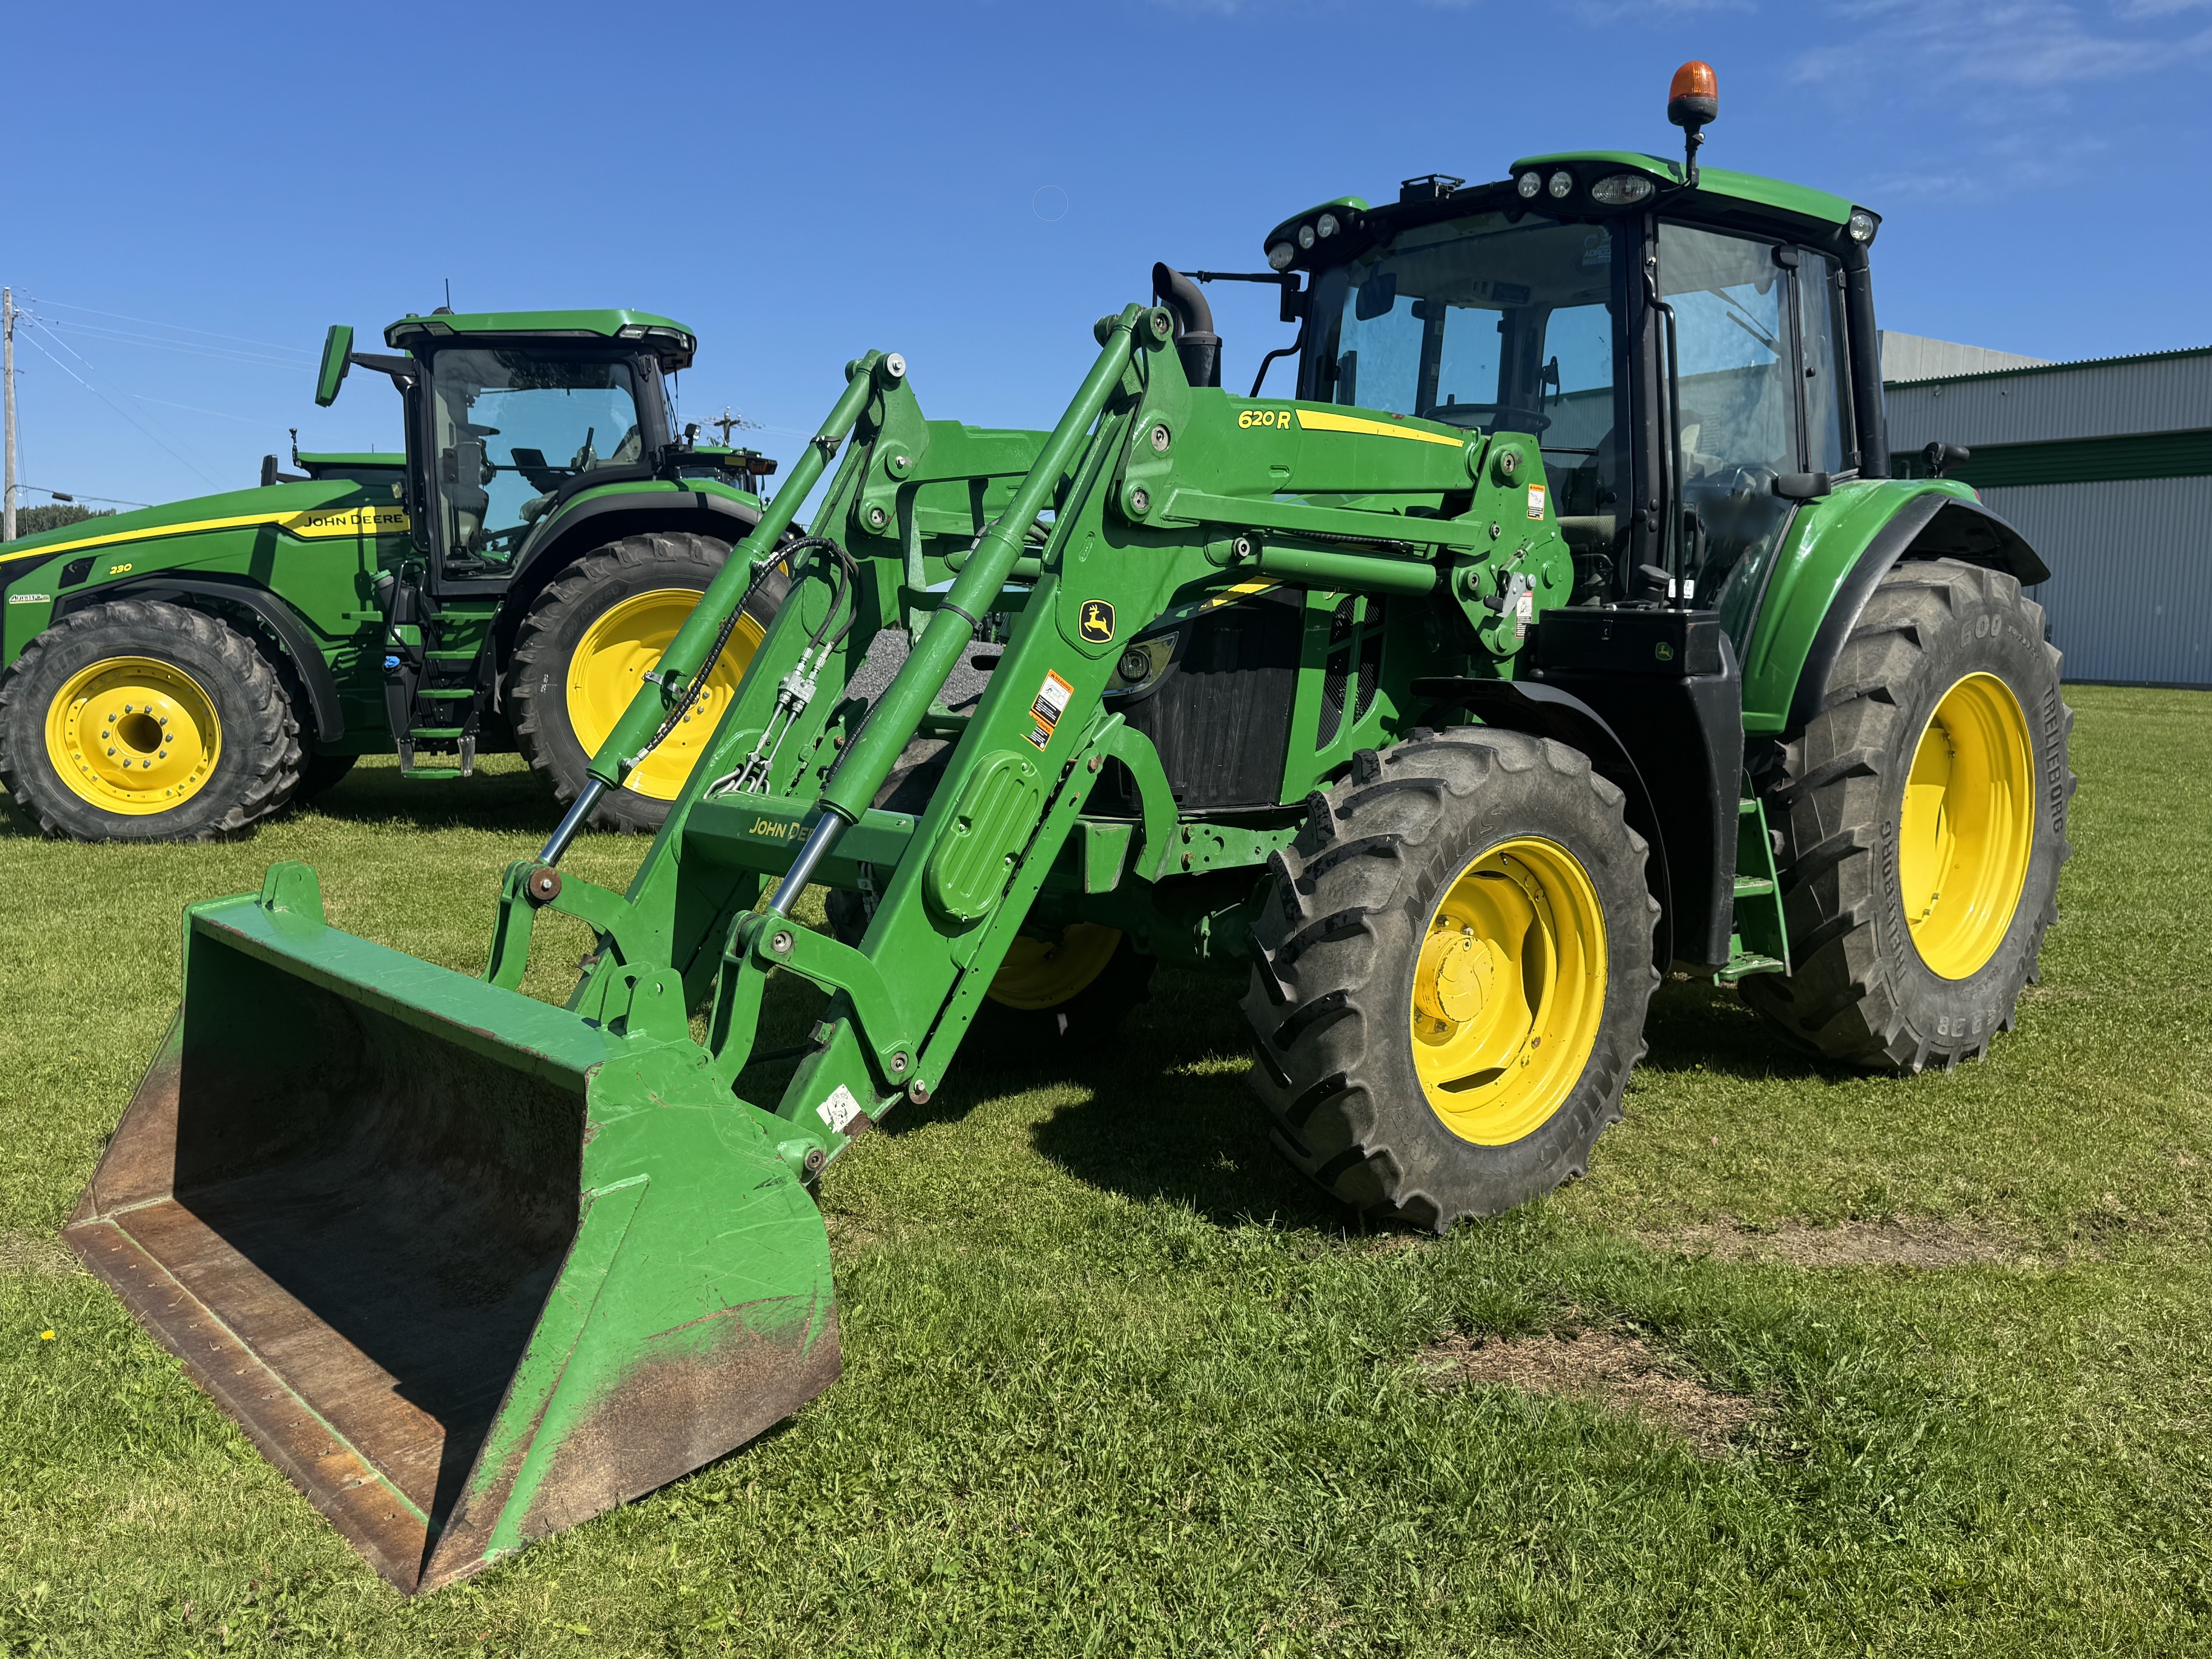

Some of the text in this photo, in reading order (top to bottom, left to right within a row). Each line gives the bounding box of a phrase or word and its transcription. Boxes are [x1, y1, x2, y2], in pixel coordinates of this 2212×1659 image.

[1238, 410, 1276, 429] 620
[303, 514, 404, 527] JOHN DEERE
[1960, 613, 2002, 649] 600
[2044, 682, 2064, 834] TRELLEBORG
[749, 817, 815, 842] JOHN DEE
[1403, 801, 1504, 946] Mitas
[1877, 820, 1906, 994] TRELLEBORG
[1536, 1031, 1622, 1173] Mitas
